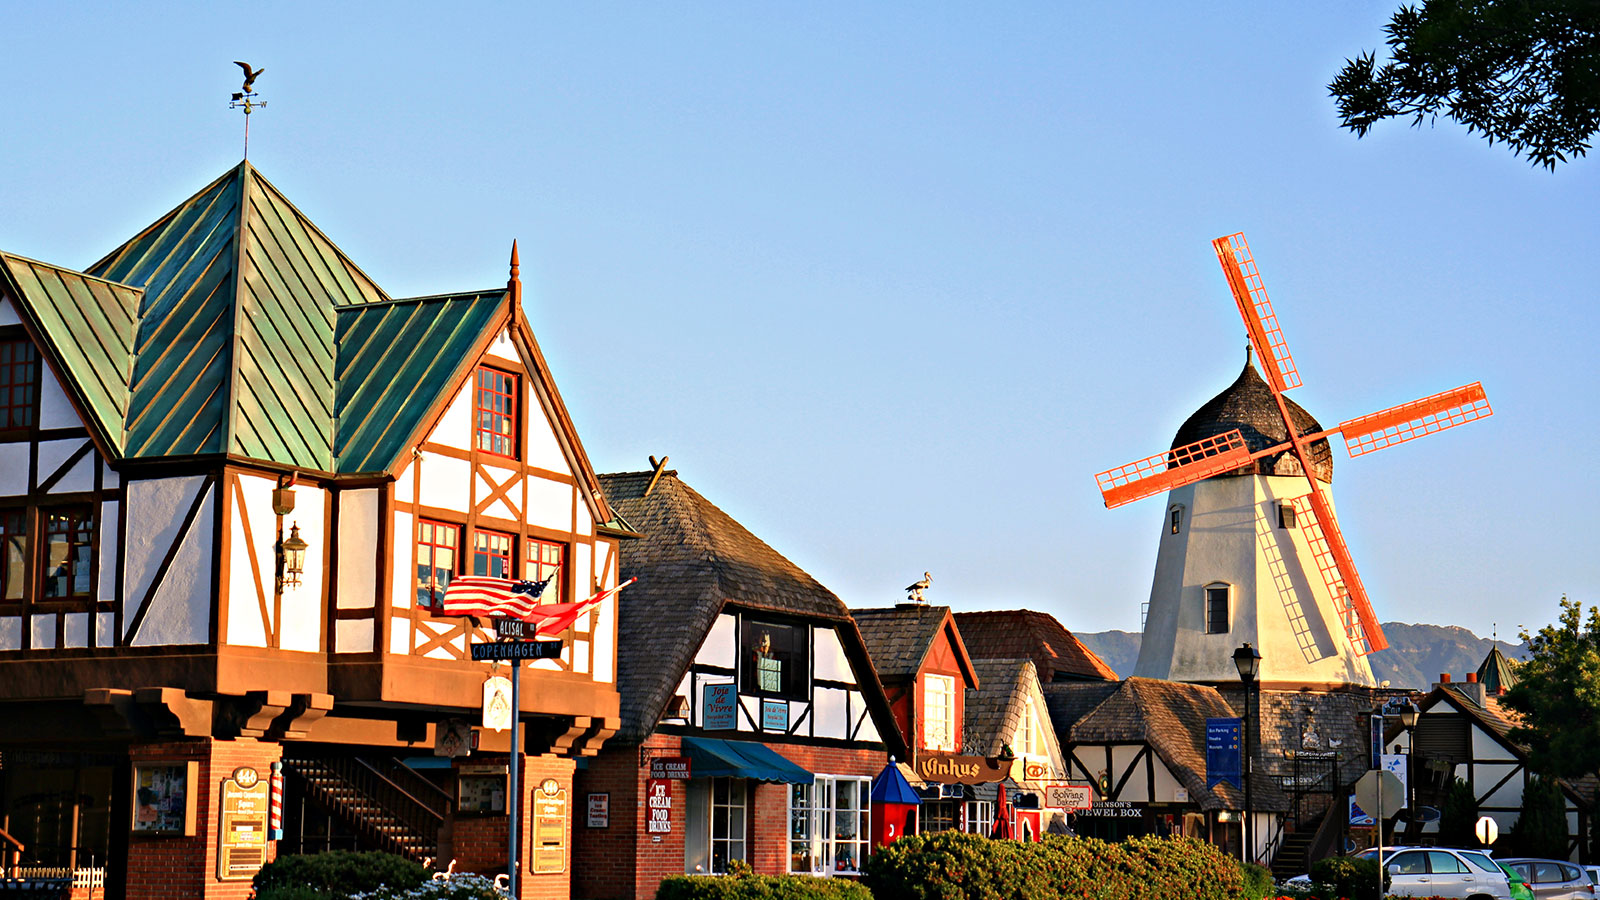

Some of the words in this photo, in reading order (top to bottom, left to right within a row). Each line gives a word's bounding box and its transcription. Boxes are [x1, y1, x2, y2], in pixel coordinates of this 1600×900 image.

[500, 620, 524, 636] ALISAL
[473, 642, 543, 658] COPENHAGEN
[712, 687, 729, 696] Joie
[715, 696, 726, 704] de
[708, 704, 733, 713] Vivre
[653, 763, 663, 771] ICE
[666, 763, 686, 771] CREAM
[921, 758, 980, 778] Vinhus
[237, 769, 257, 784] 446
[651, 771, 665, 779] FOOD
[667, 771, 689, 779] DRINKS
[655, 785, 666, 797] ICE
[1053, 788, 1084, 801] Solvang
[649, 796, 672, 809] CREAM
[1057, 799, 1080, 808] Bakery
[652, 809, 668, 821] FOOD
[1080, 808, 1118, 817] JEWEL
[1120, 808, 1142, 817] BOX
[649, 820, 671, 832] DRINKS
